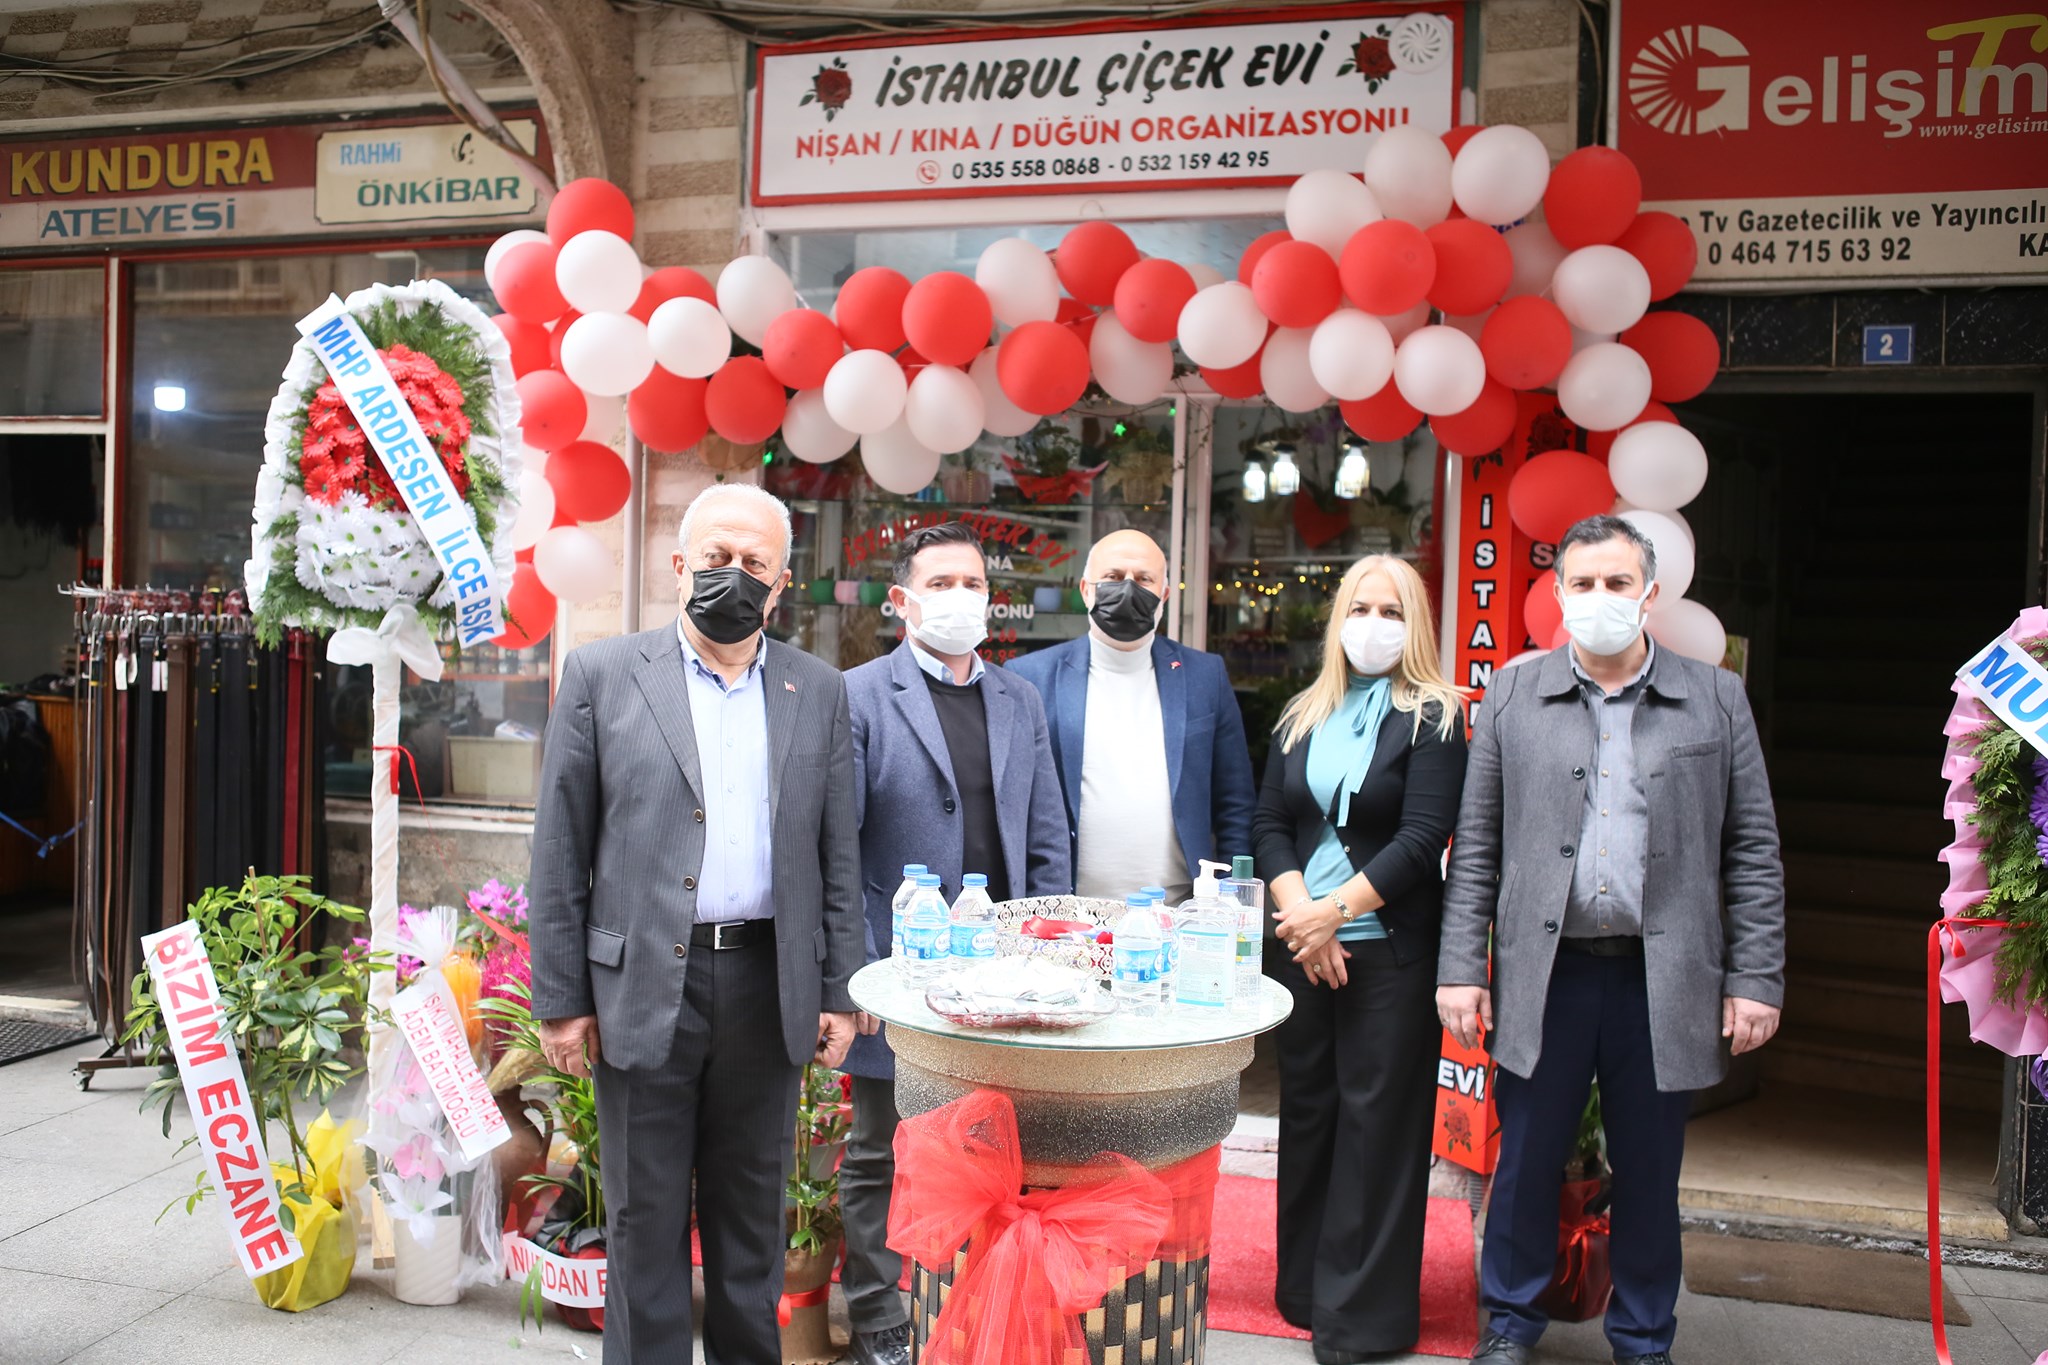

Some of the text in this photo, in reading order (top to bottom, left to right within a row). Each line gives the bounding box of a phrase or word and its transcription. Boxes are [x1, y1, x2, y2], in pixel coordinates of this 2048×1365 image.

[875, 30, 1330, 107] İSTANBUL ÇİÇEK EVİ
[796, 129, 881, 165] NİŞAN
[912, 126, 981, 153] KINA
[1012, 115, 1121, 148] DÜĞÜN
[952, 162, 964, 179] 0
[970, 160, 1004, 178] 535
[1011, 159, 1046, 177] 558
[1052, 157, 1100, 176] 0868
[1121, 155, 1133, 173] 0
[1138, 154, 1172, 172] 532
[1179, 153, 1212, 170] 159
[1217, 151, 1241, 169] 42
[1246, 150, 1270, 168] 95
[10, 136, 274, 196] KUNDURA
[1699, 210, 1728, 234] Tv
[1738, 204, 1882, 232] Gazetecilik
[1892, 210, 1921, 228] ve
[1708, 237, 1912, 265] 0 464 715 63 92
[1879, 333, 1894, 356] 2
[313, 317, 495, 644] MHP ARDEŞEN İLÇE BŞK
[155, 931, 290, 1271] BİZİM ECZANE
